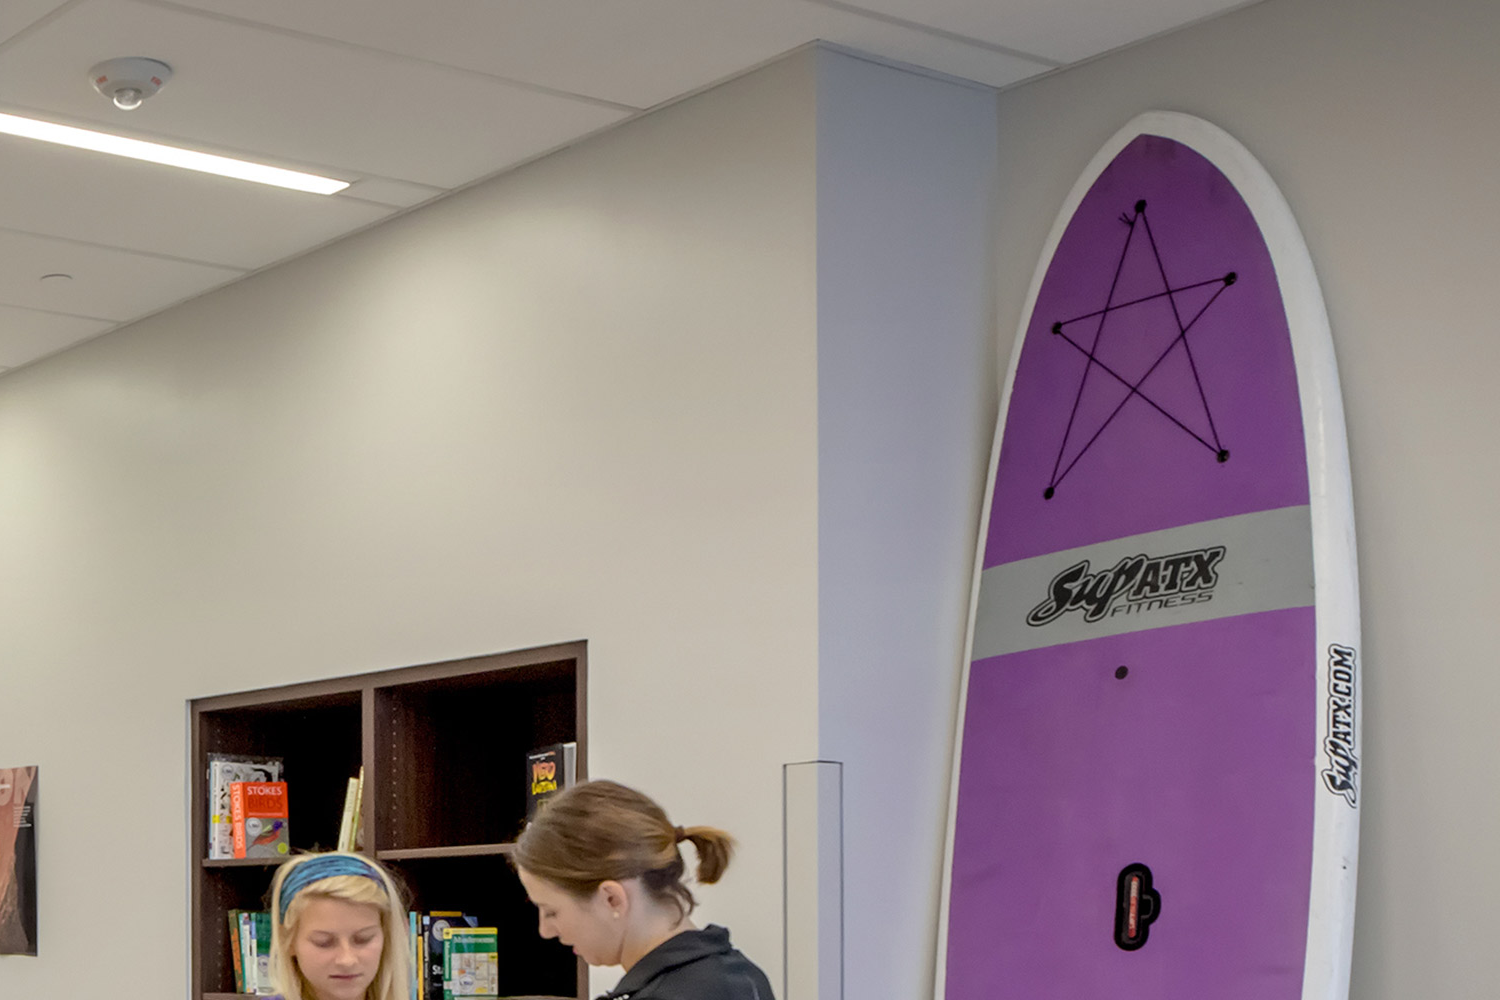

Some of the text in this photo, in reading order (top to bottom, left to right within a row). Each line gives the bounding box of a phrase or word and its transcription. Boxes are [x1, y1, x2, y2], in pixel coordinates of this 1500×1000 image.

[1111, 590, 1214, 617] FITNESS
[247, 786, 283, 796] STOKES
[231, 783, 242, 821] STOKES
[247, 799, 283, 810] BIRDS
